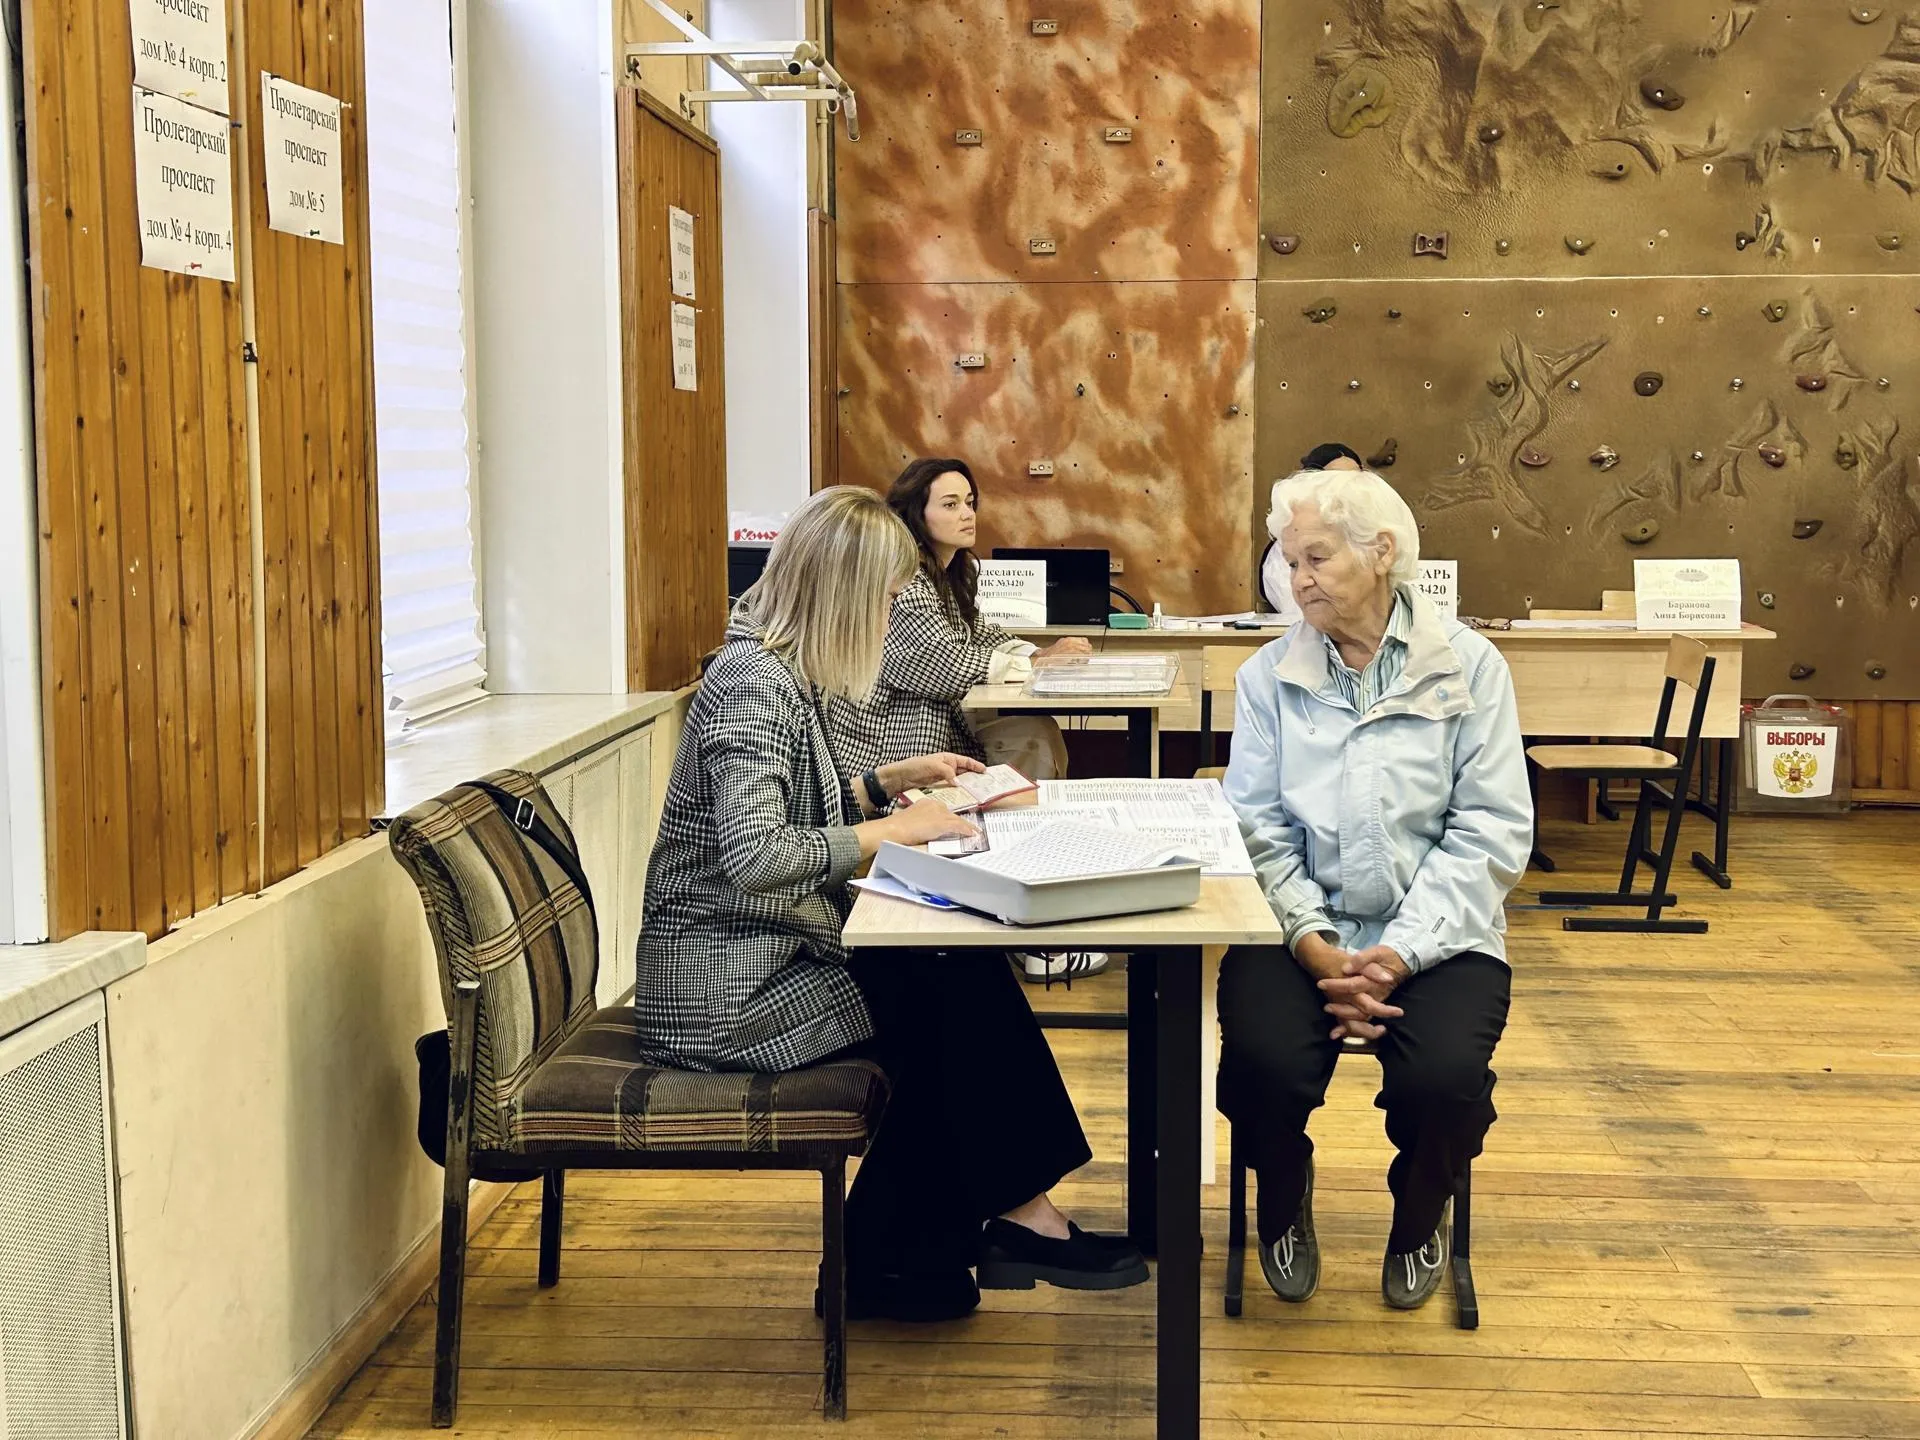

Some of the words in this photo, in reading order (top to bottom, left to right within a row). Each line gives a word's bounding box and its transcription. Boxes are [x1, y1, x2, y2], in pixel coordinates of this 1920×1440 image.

[155, 0, 209, 23] роспект
[140, 38, 161, 61] дом
[164, 40, 176, 66] №
[179, 47, 186, 69] 4
[189, 55, 218, 82] корп.
[219, 60, 226, 82] 2
[270, 86, 337, 132] Пролетарский
[144, 106, 226, 155] Пролетарский
[284, 139, 327, 166] проспект
[162, 165, 216, 195] проспект
[289, 190, 304, 208] дом
[306, 189, 317, 211] №
[319, 193, 325, 213] 5
[146, 219, 168, 240] дом
[170, 217, 182, 242] №
[185, 221, 191, 243] 4
[195, 229, 223, 253] корп.
[226, 229, 232, 251] 4
[1668, 600, 1711, 610] Баранова
[1767, 732, 1825, 746] ВЫБОРЫ
